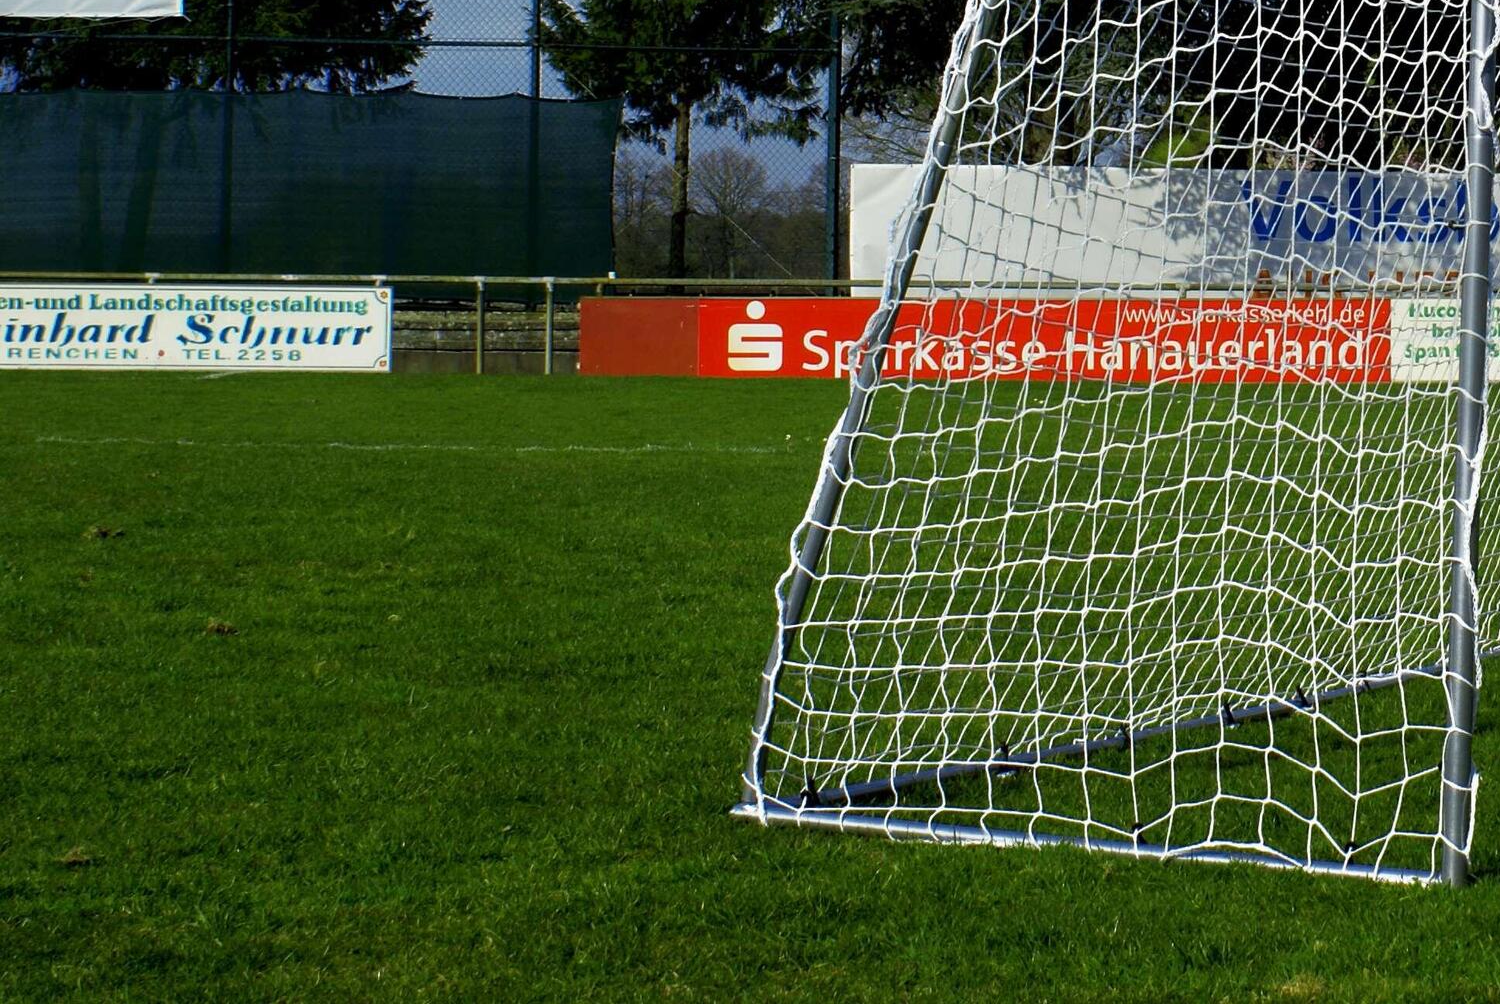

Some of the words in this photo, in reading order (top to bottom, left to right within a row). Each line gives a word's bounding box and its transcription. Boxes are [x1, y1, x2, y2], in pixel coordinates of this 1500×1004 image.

[89, 293, 368, 315] Landschaftsgestaltung
[0, 312, 155, 347] inhard
[176, 313, 373, 349] Schnurr
[8, 347, 139, 359] RENCHEN
[802, 328, 1046, 379] Sprkasse
[1065, 329, 1363, 371] Hanauerland
